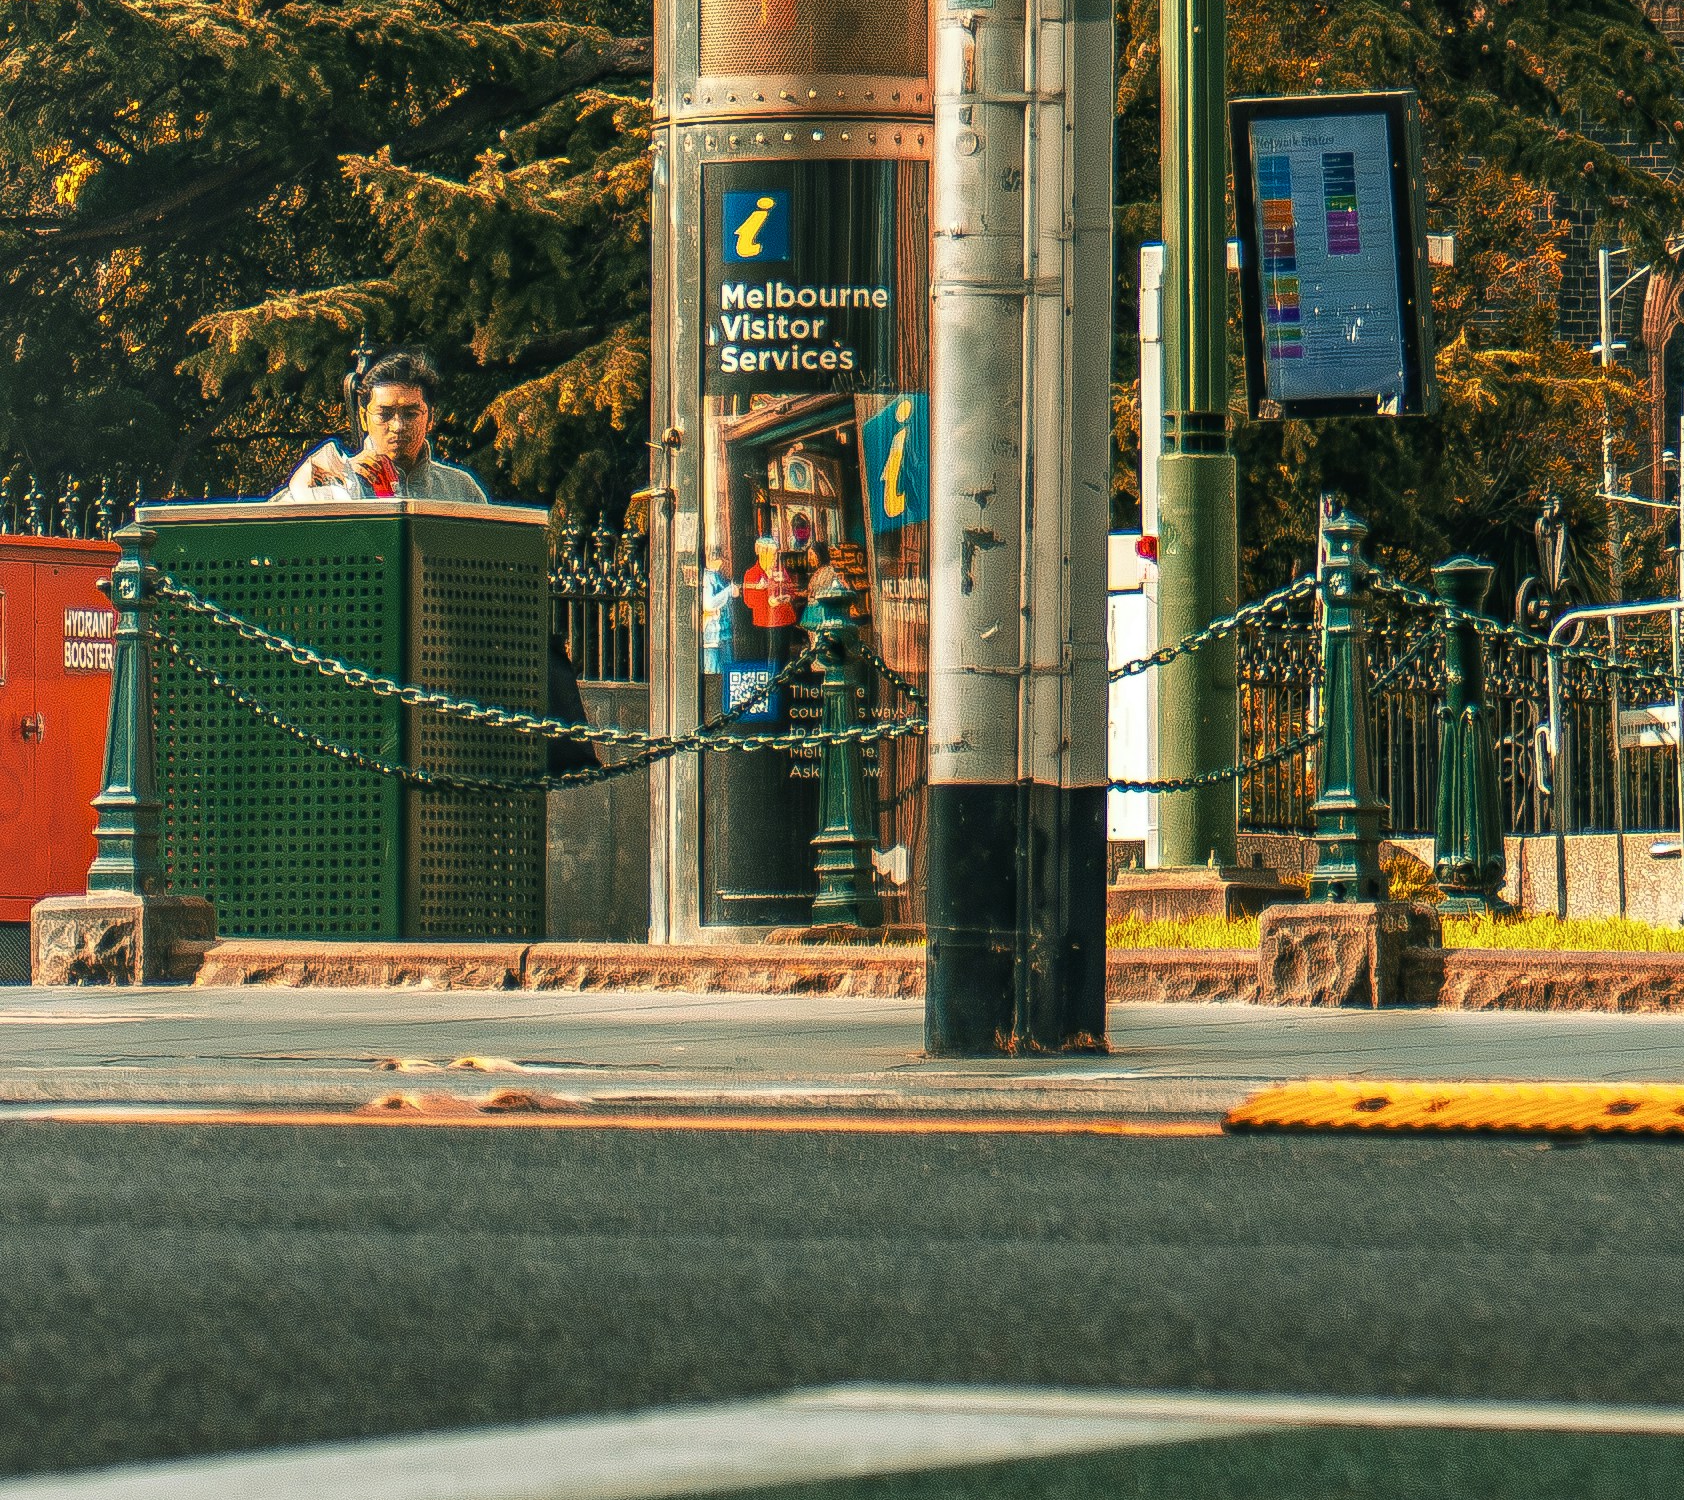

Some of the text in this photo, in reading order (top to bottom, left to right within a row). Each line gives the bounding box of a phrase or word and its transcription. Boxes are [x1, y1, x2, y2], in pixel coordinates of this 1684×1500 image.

[720, 282, 888, 310] Melbourne
[720, 313, 825, 342] Visitor
[720, 345, 854, 373] Services
[64, 609, 113, 638] HYDRANT
[64, 641, 113, 669] BOOSTER
[789, 764, 820, 778] Ask
